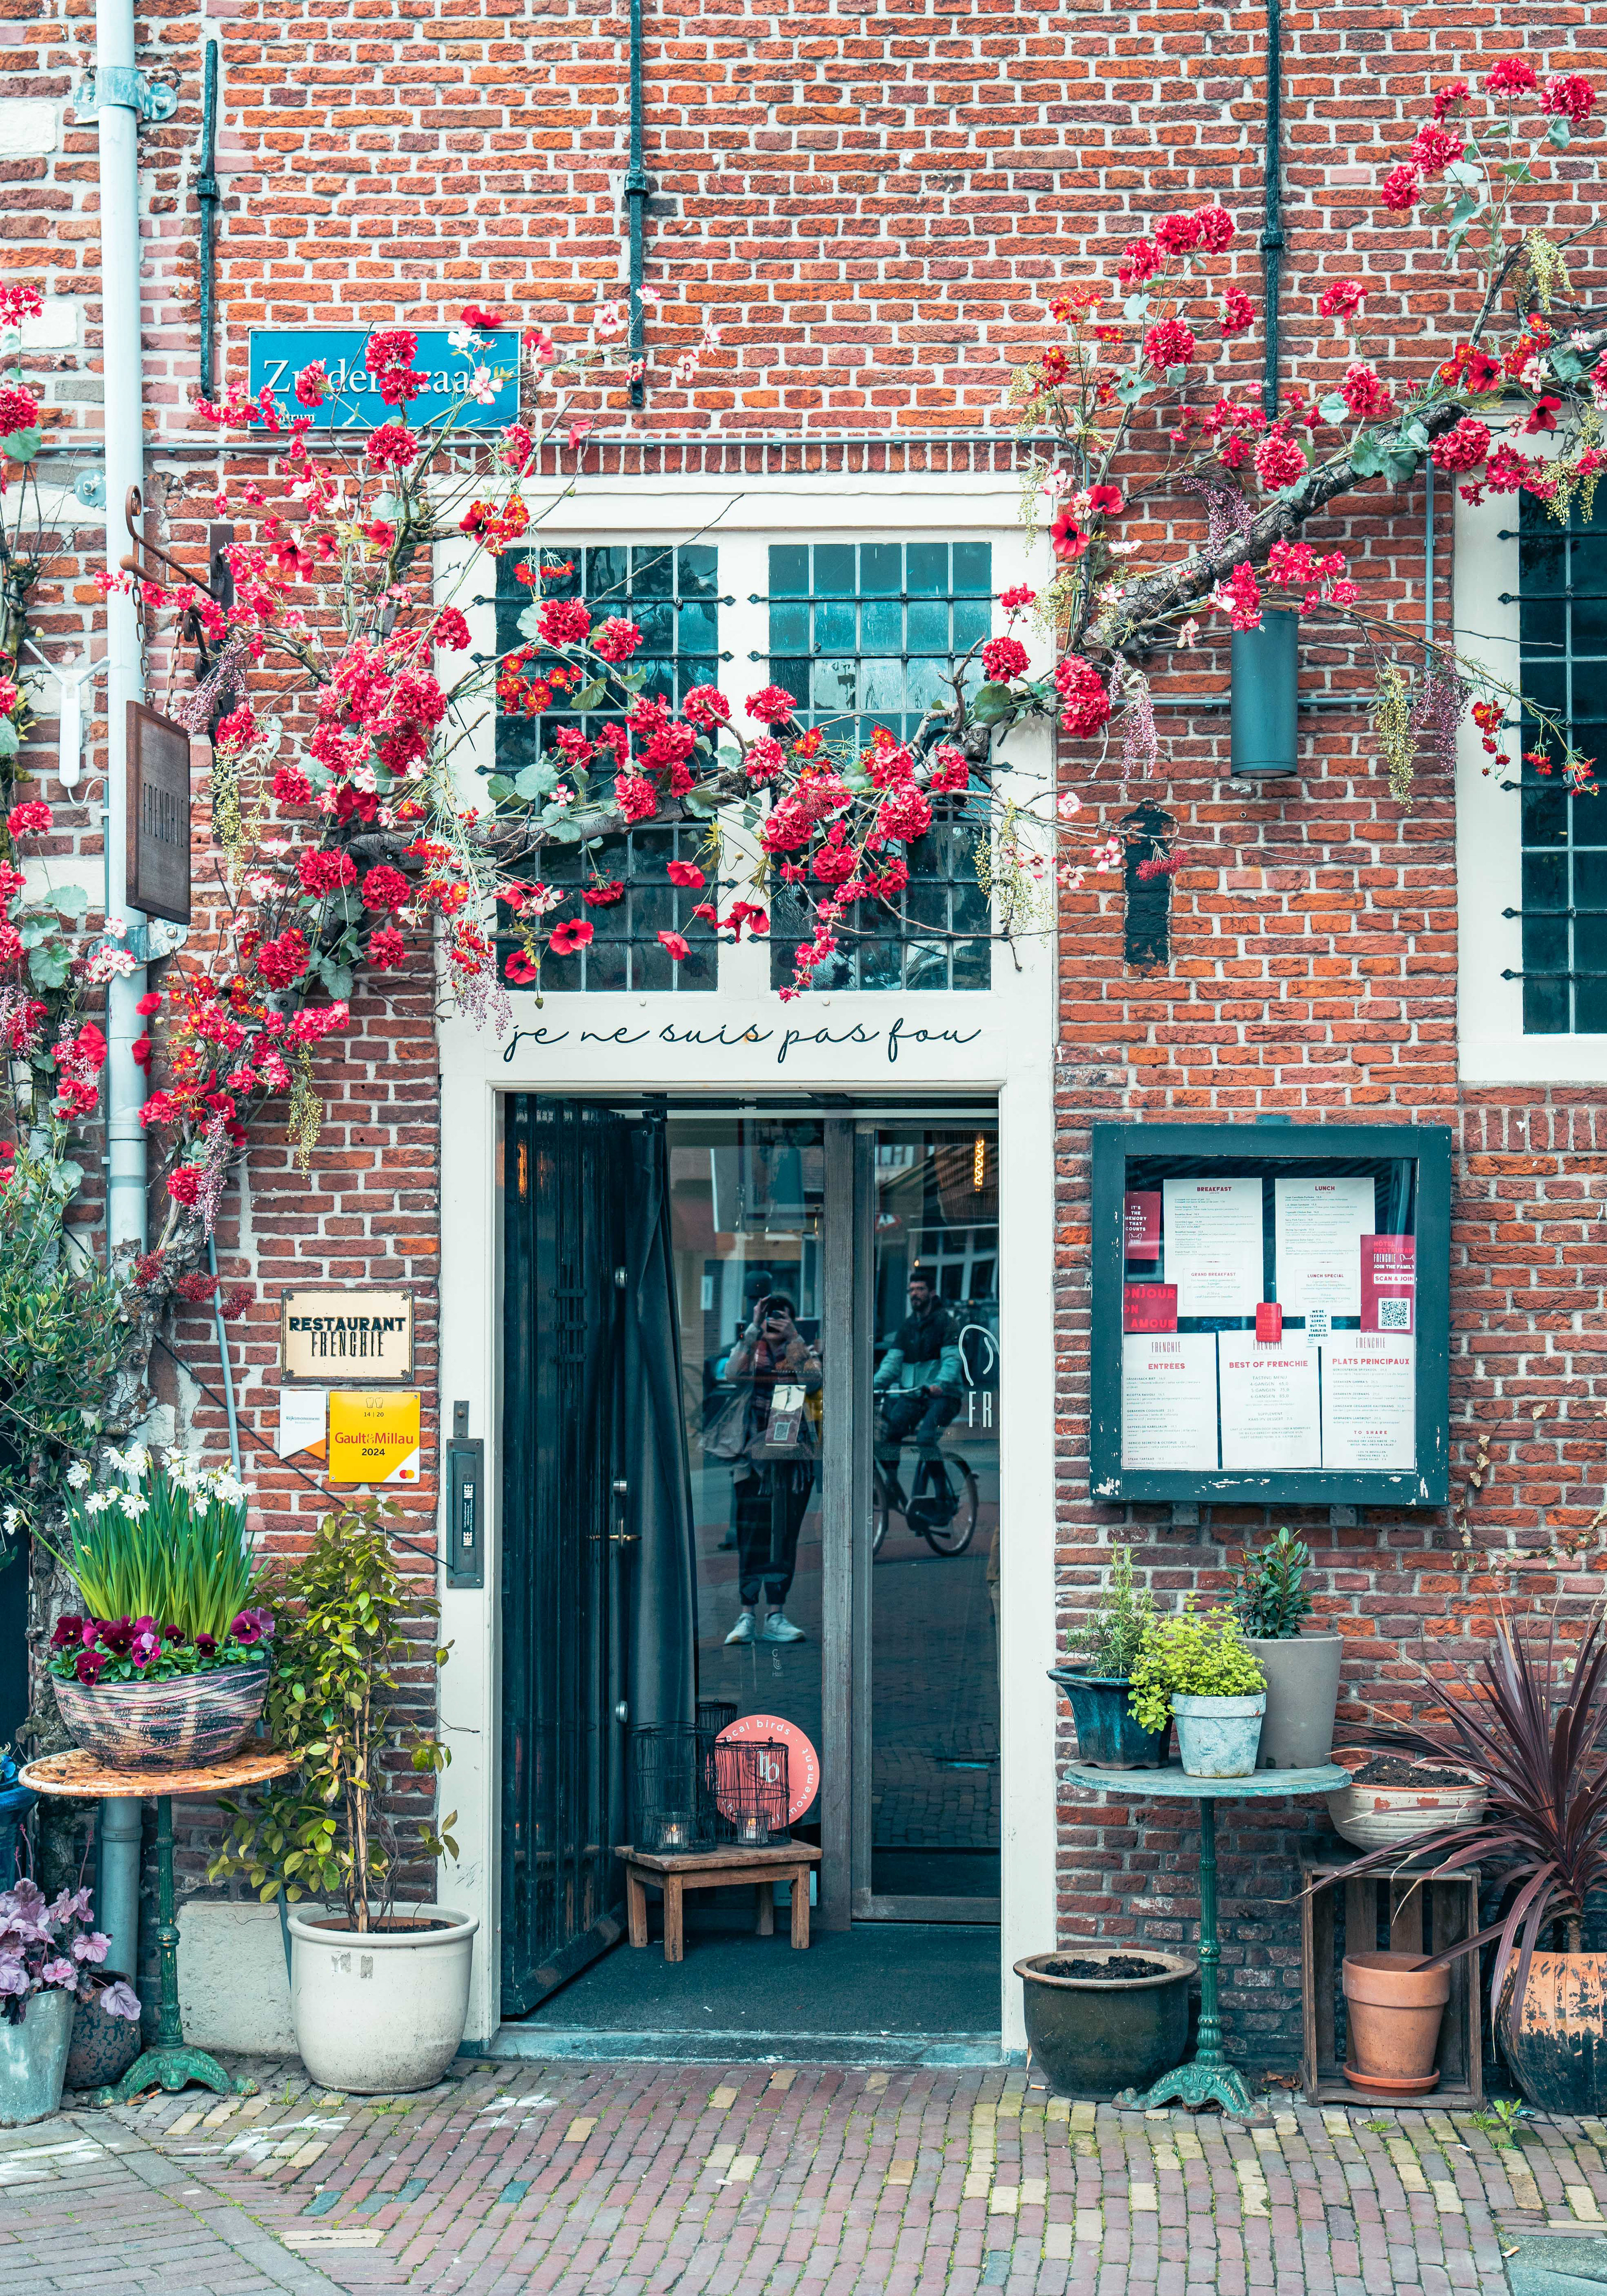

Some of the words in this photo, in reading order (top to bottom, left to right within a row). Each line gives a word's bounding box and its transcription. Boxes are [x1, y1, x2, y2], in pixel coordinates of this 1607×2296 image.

[144, 783, 184, 848] FRENCHIE
[503, 1025, 569, 1062] je
[581, 1027, 650, 1043] ne
[659, 1024, 773, 1045] suis
[778, 1023, 880, 1063] pas
[888, 1017, 981, 1063] fou
[1374, 1254, 1396, 1262] FRENCHIE
[288, 1317, 406, 1331] RESTAURANT
[1131, 1318, 1176, 1328] AMOUR
[311, 1331, 385, 1357] FRENCHIE
[1152, 1341, 1181, 1353] FRENCHIE
[1356, 1338, 1385, 1348] FRENCHIE
[1148, 1361, 1185, 1370] ENTRÉES
[335, 1432, 413, 1444] Gault&Millau
[464, 1484, 473, 1498] NEE
[463, 1532, 472, 1546] NEE
[720, 1722, 750, 1743] ocal
[757, 1720, 790, 1736] birds
[788, 1748, 814, 1817] movement
